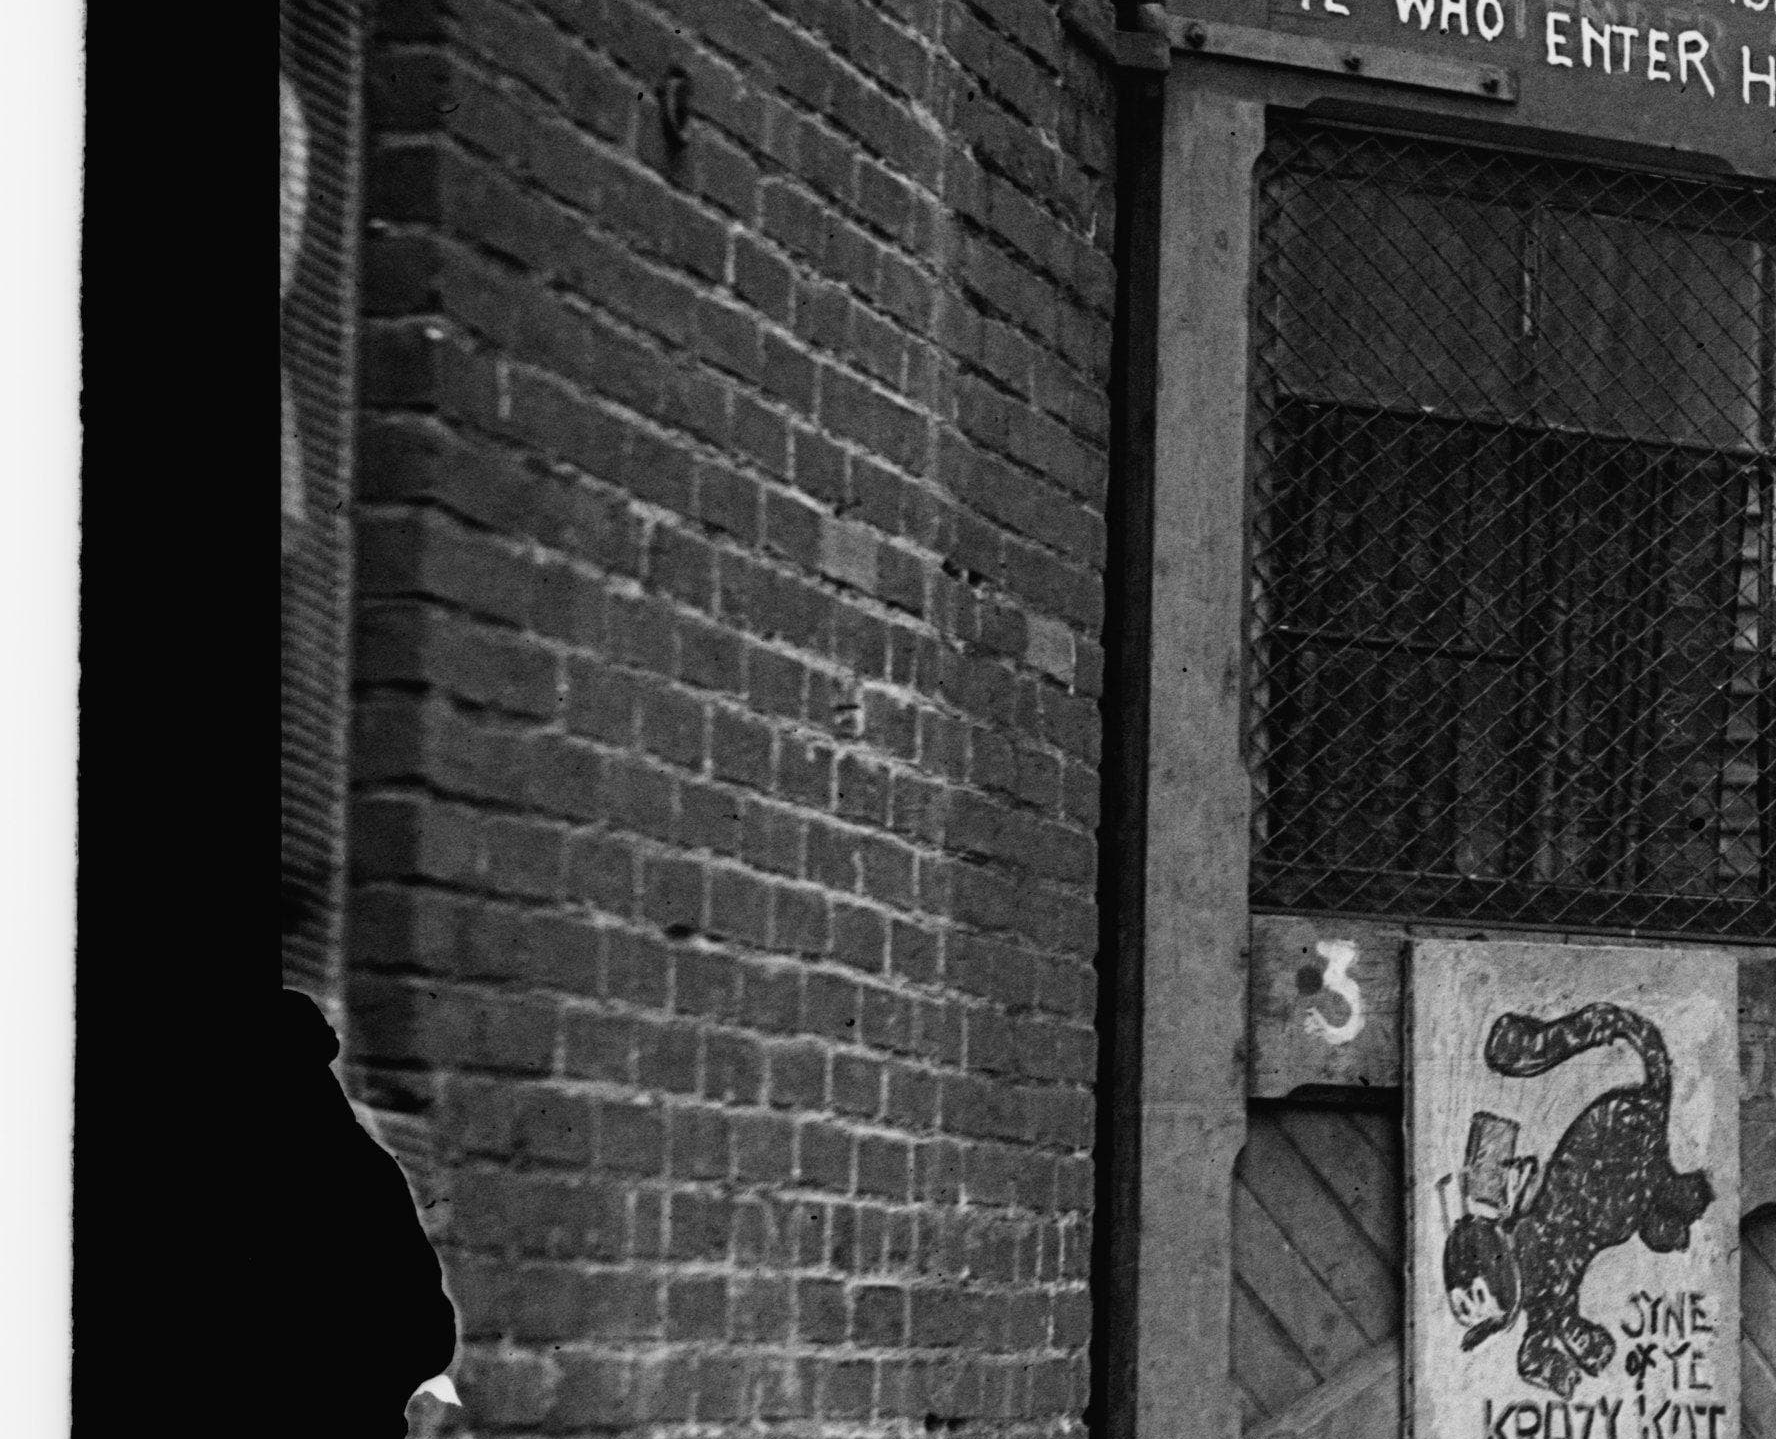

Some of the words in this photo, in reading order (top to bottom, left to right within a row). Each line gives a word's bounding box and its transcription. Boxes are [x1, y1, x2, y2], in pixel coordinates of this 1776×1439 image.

[1545, 9, 1716, 97] ENTER
[1304, 938, 1366, 1046] 3
[1662, 1341, 1713, 1391] YE
